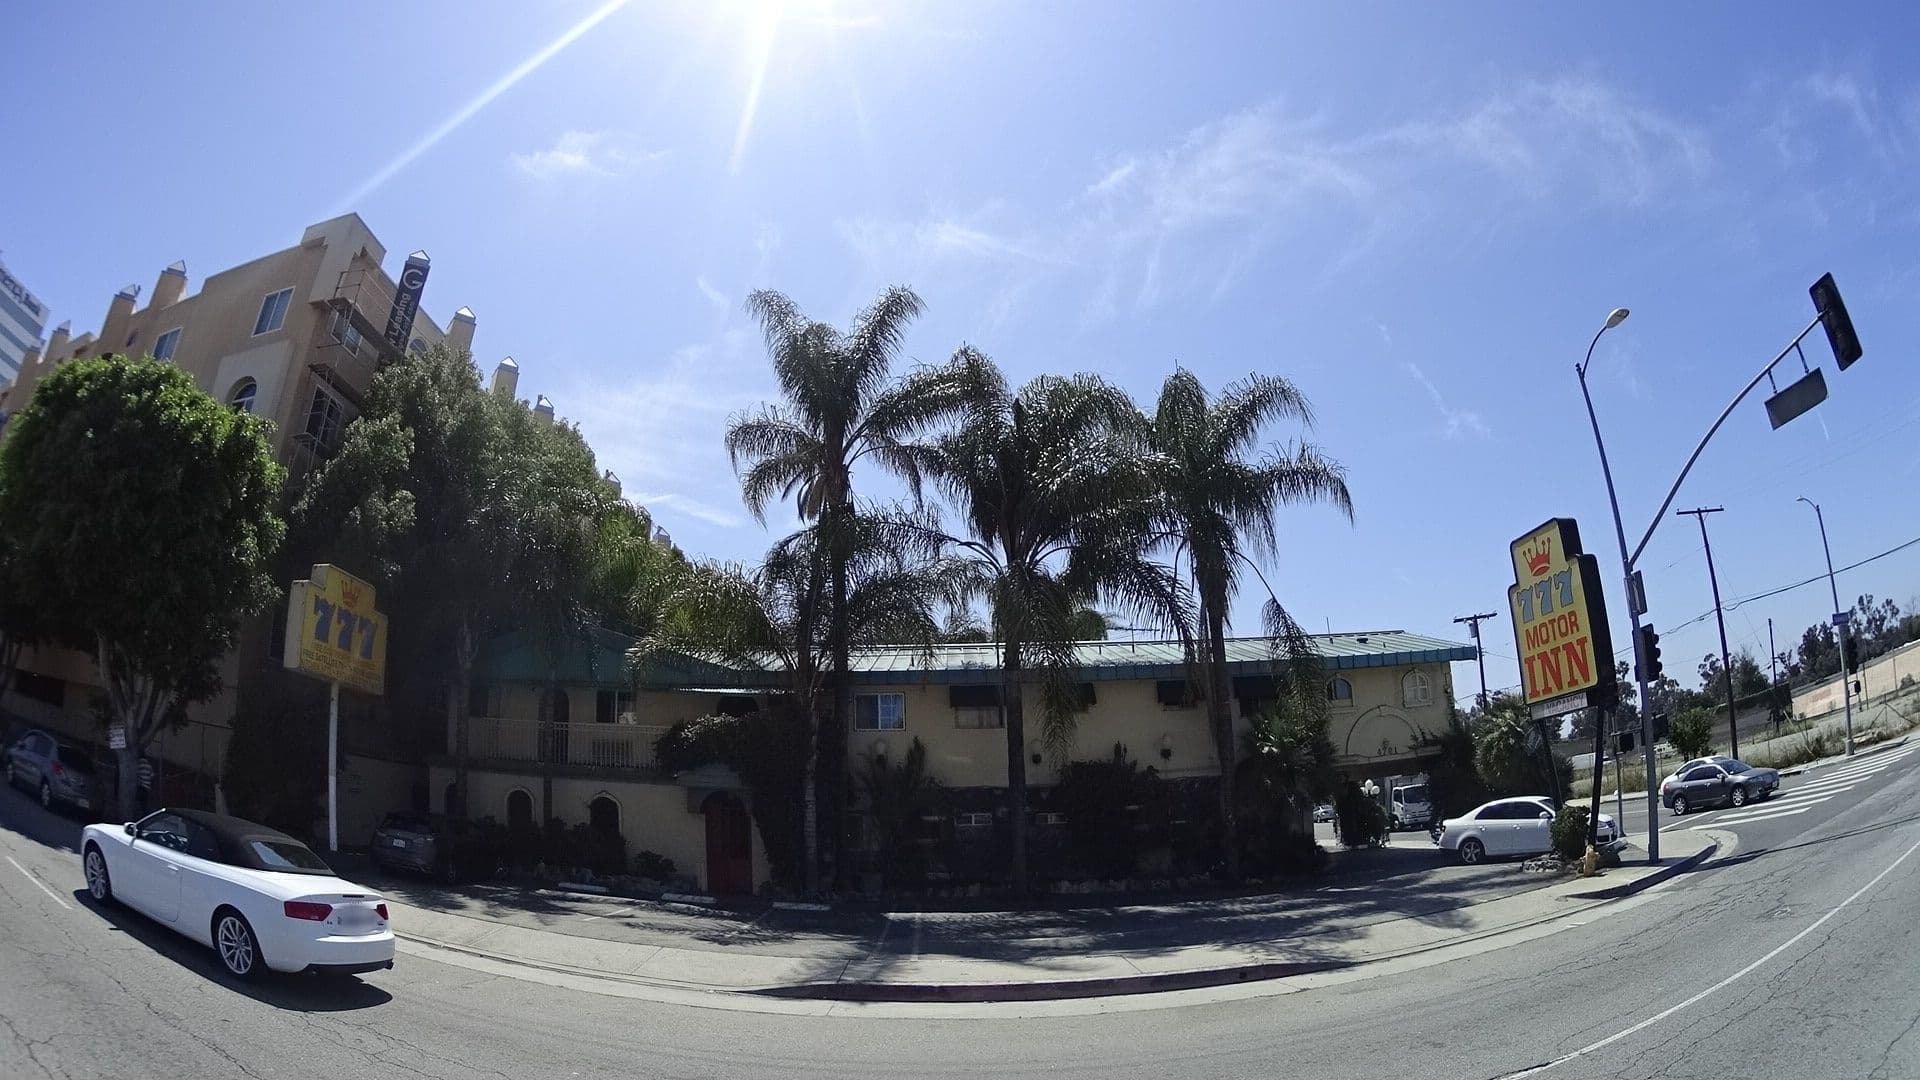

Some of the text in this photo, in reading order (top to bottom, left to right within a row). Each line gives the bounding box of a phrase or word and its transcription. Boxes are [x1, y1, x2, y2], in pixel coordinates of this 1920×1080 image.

[402, 268, 424, 290] G
[389, 293, 412, 337] Leasing
[1516, 567, 1574, 624] 777
[313, 594, 379, 661] 777
[1525, 610, 1580, 651] MOTOR
[1524, 636, 1591, 700] INN
